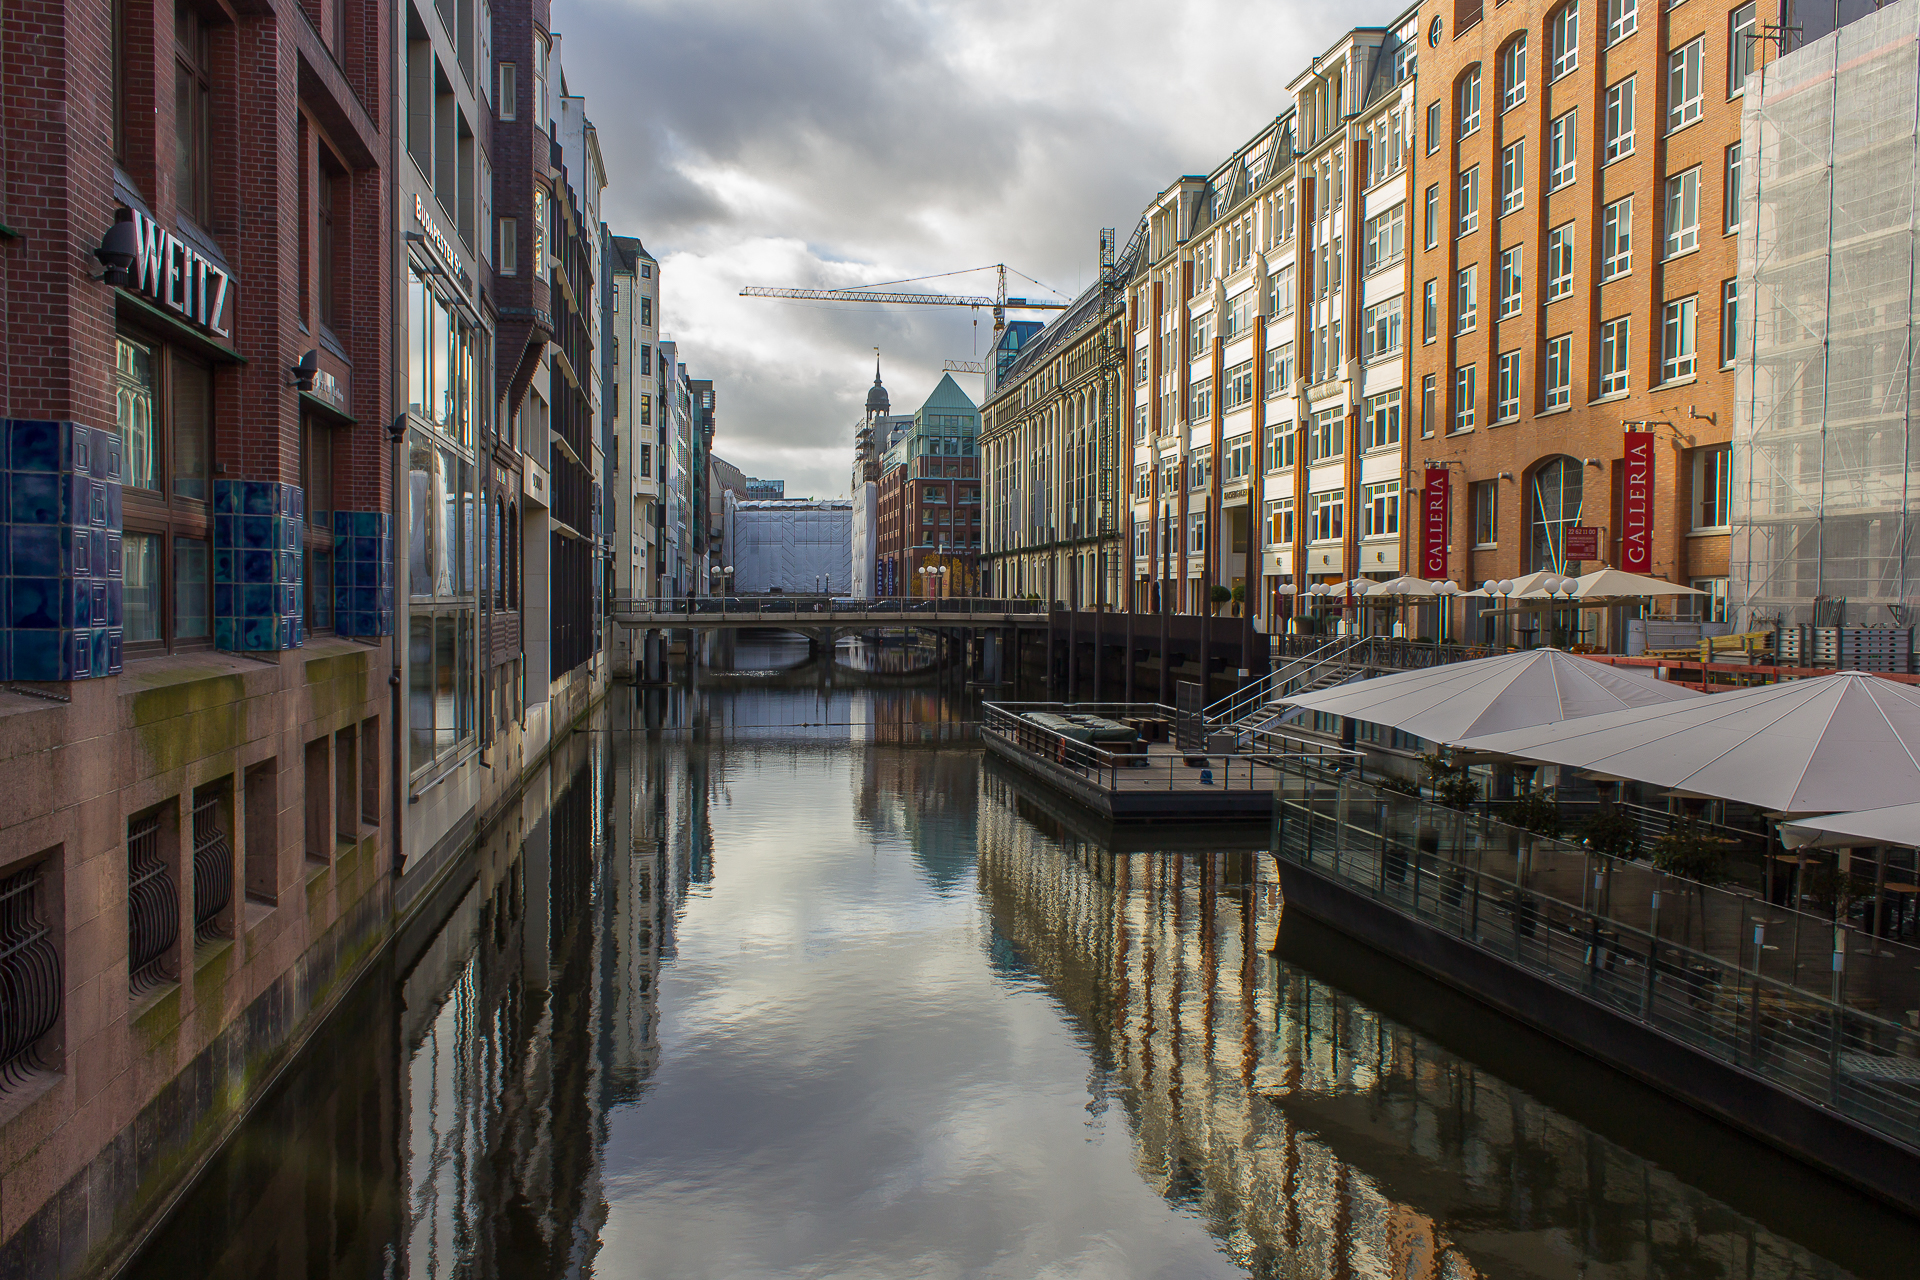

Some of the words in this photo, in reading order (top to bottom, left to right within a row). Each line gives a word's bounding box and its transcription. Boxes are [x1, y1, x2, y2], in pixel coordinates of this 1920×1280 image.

[132, 208, 228, 339] WEITZ
[416, 193, 454, 269] BUDAPESTER
[1429, 477, 1443, 571] GALLERIA
[1628, 443, 1647, 563] GALLERIA
